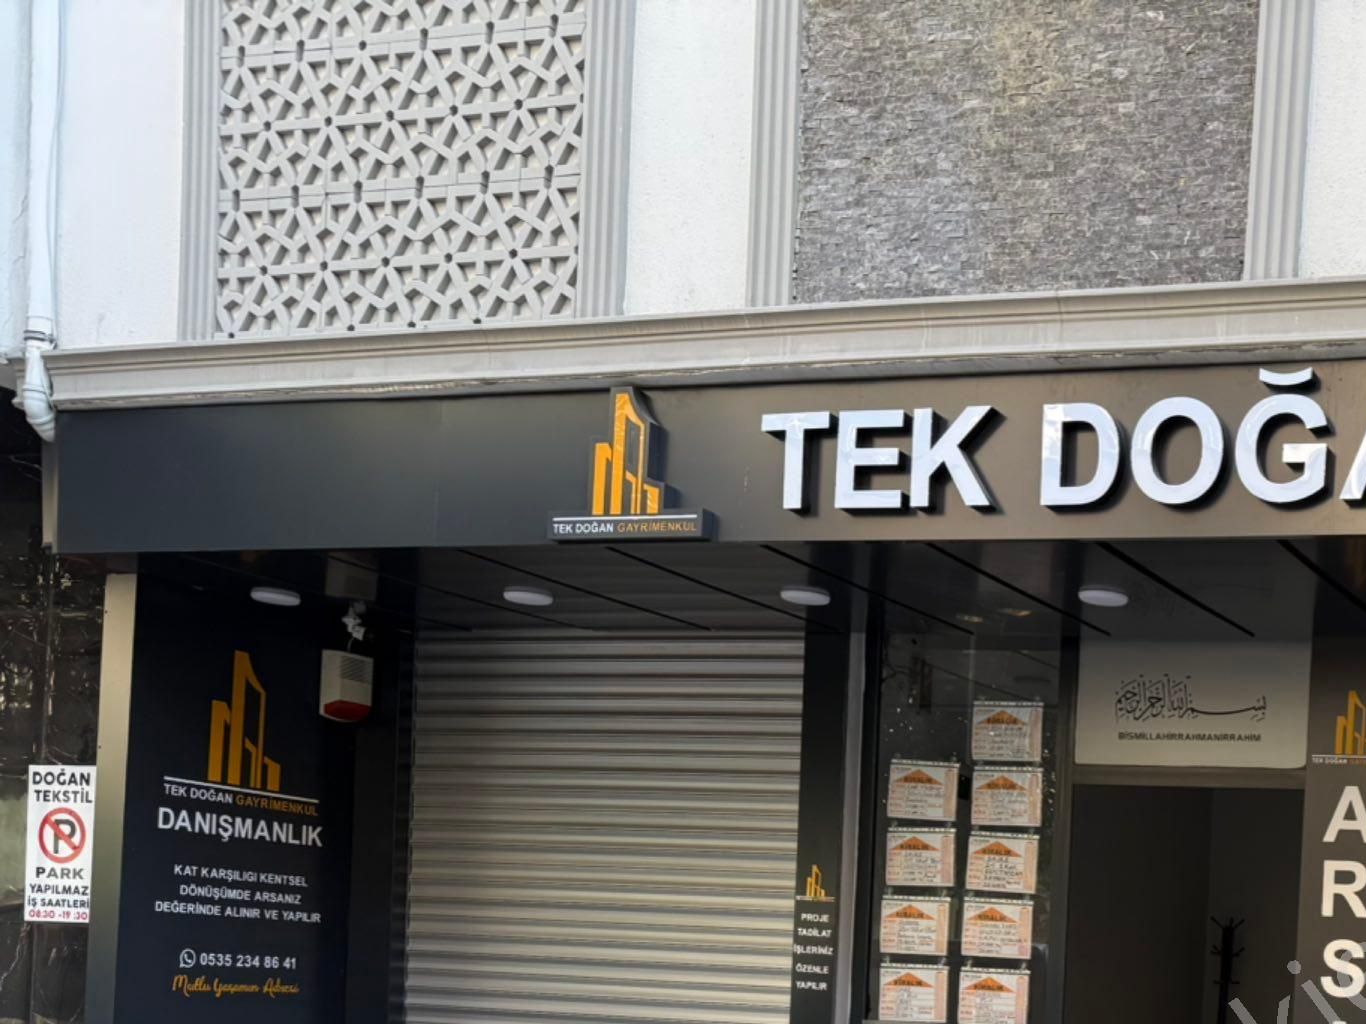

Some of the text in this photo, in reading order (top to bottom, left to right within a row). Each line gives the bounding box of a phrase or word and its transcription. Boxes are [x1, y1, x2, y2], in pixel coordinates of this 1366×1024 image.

[761, 405, 997, 511] TEK
[552, 519, 697, 534] TEK DOĞAN GAYRİMENKUL
[32, 768, 91, 786] DOĞAN
[34, 788, 93, 804] TEKSTİL
[164, 783, 319, 816] TEK DOĞAN GAYRİMENKUL
[157, 806, 323, 847] DANIŞMANLIK
[35, 866, 85, 880] PARK
[174, 864, 199, 876] KAT
[259, 872, 309, 888] KENTSEL
[29, 883, 89, 896] YAPILMAZ
[179, 882, 302, 905] DÖNÜŞÜMDE ARSANIZ
[27, 896, 90, 909] İŞ SAATLERİ
[155, 899, 322, 924] DEĞERİNDE ALINIR VE YAPILIR
[801, 913, 830, 923] PROJE
[797, 927, 832, 938] TADİLAT
[199, 952, 297, 970] 0535 234 86 41
